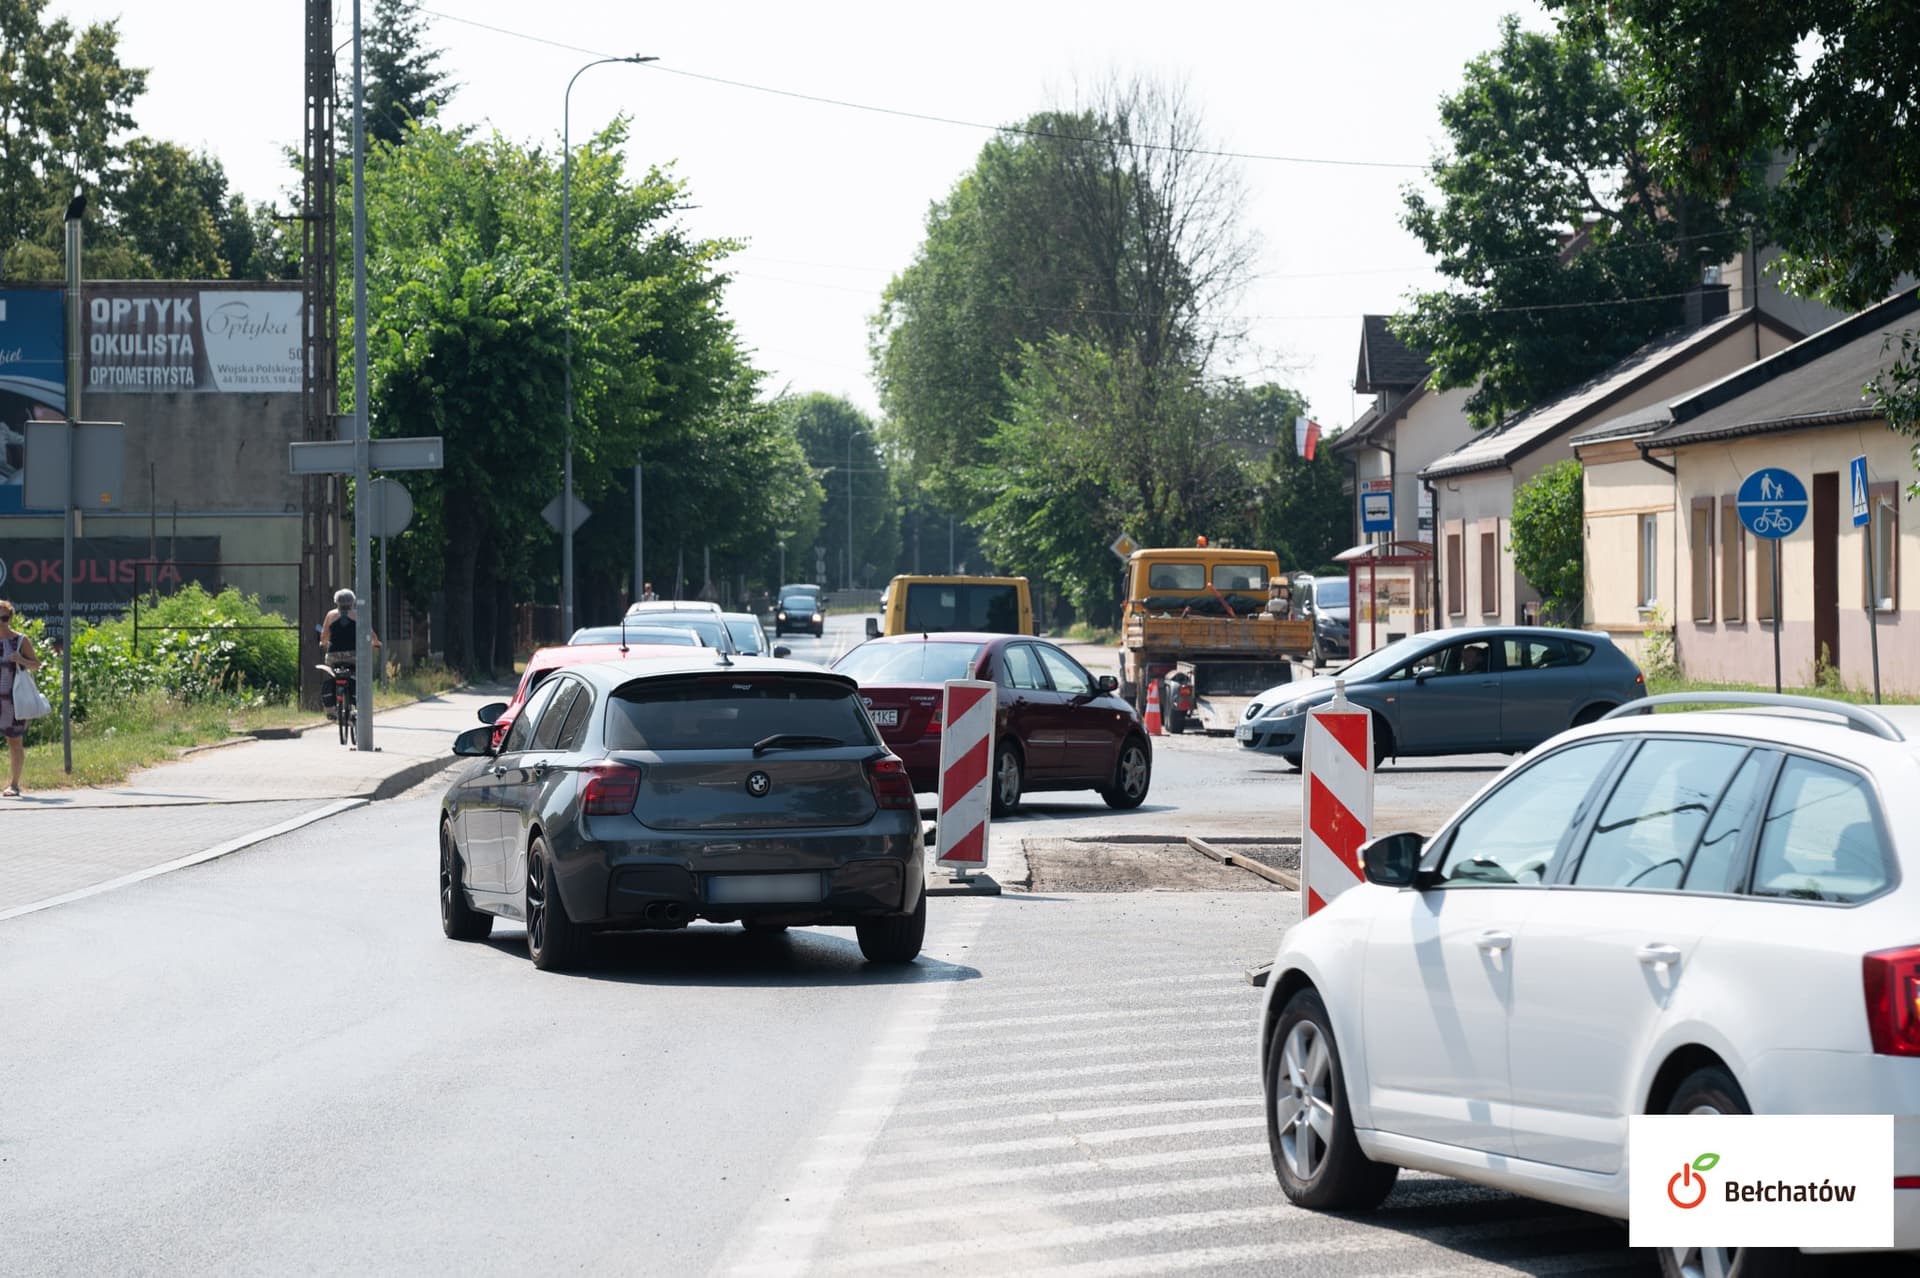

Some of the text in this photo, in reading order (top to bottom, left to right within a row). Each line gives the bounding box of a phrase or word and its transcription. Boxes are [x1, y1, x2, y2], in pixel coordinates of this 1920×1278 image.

[90, 297, 193, 323] OPTYK
[206, 301, 288, 340] Optyka
[90, 333, 194, 355] OKULISTA
[90, 366, 195, 385] OPTOMETRYSTA
[217, 363, 254, 375] Wojska
[12, 559, 182, 584] OKULISTA
